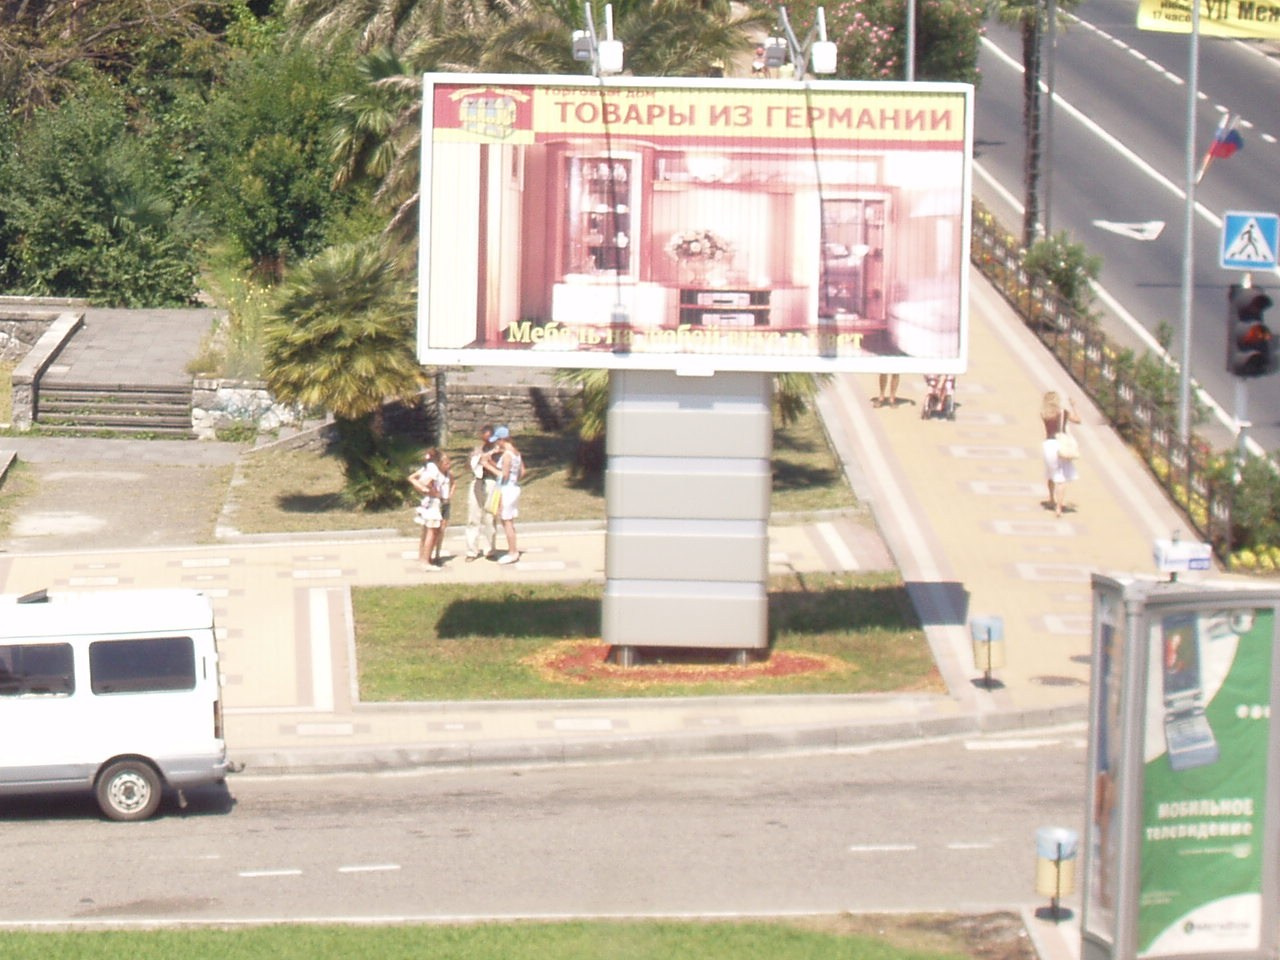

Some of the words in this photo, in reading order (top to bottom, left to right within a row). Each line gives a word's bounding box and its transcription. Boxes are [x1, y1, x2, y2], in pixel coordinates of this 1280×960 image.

[1165, 13, 1192, 22] часо
[554, 101, 696, 126] ТОВАРЫ
[709, 105, 753, 127] ИЗ
[766, 106, 953, 131] ГЕРМАНИИ
[1158, 799, 1254, 819] МОБИЛЬНОЕ
